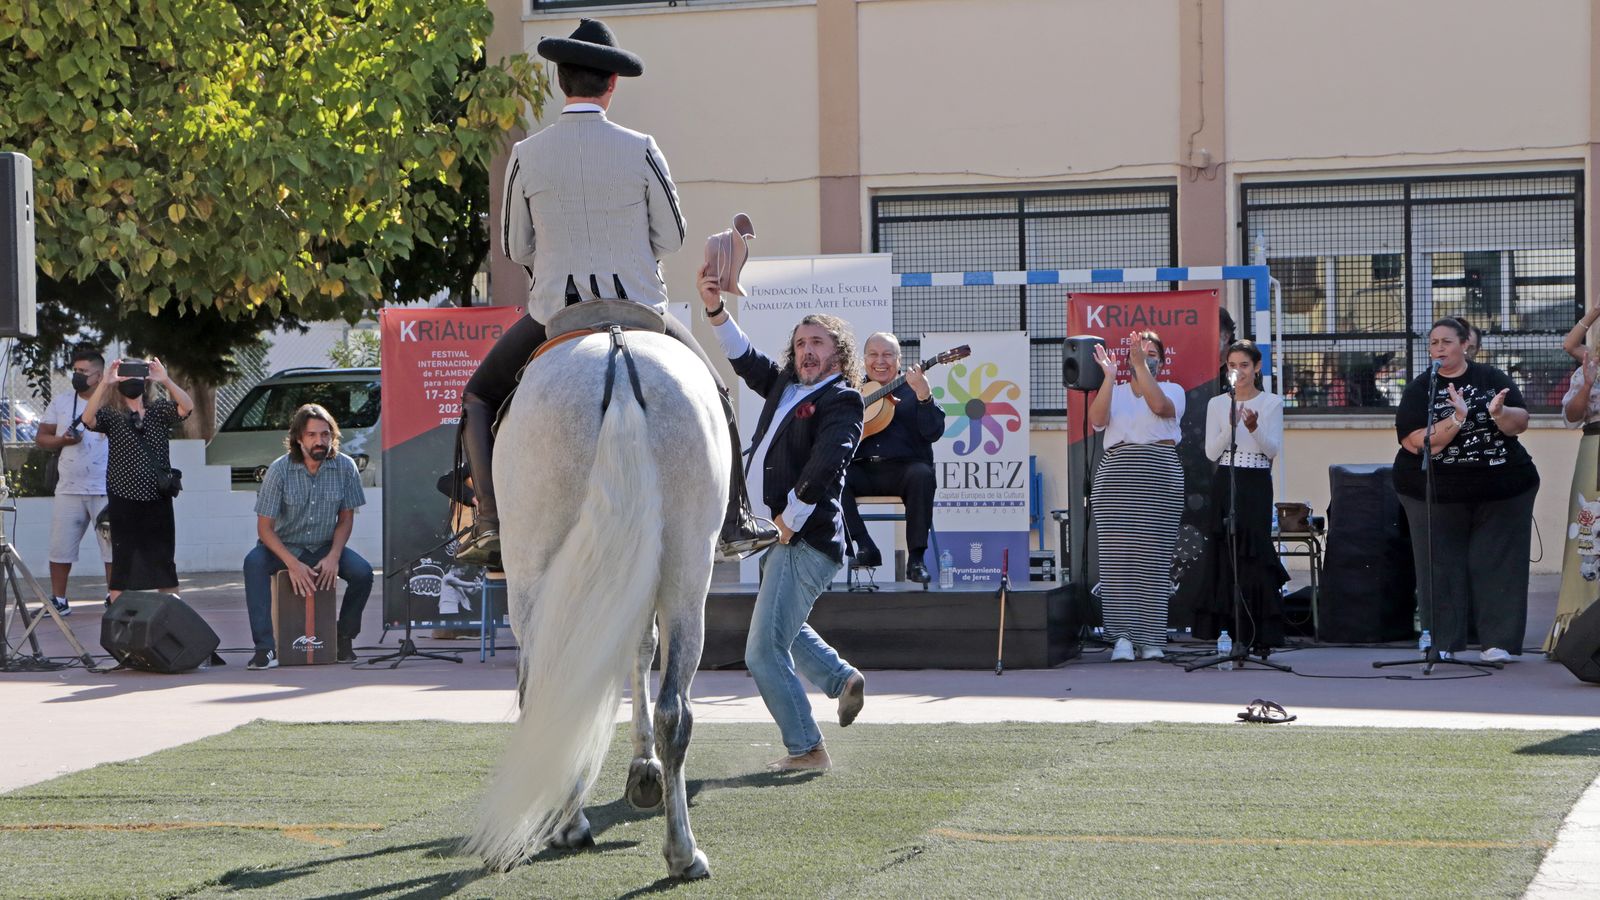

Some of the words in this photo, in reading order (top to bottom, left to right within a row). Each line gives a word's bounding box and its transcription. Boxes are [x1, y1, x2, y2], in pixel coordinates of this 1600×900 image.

[811, 284, 835, 295] REAL
[838, 283, 878, 294] ESCUELA
[743, 301, 794, 311] ANDALUZA
[796, 302, 812, 310] DEL
[814, 299, 839, 309] ARTE
[842, 297, 889, 308] ECUESTRE
[1086, 305, 1198, 328] KRiAtura
[400, 320, 503, 342] KRiAtura
[431, 350, 470, 358] FESTIVAL
[435, 369, 476, 377] FLAMENC
[444, 379, 469, 387] niños/
[425, 390, 457, 400] 17-23
[933, 461, 1025, 489] EREZ
[952, 567, 1001, 575] Ayuntamiento
